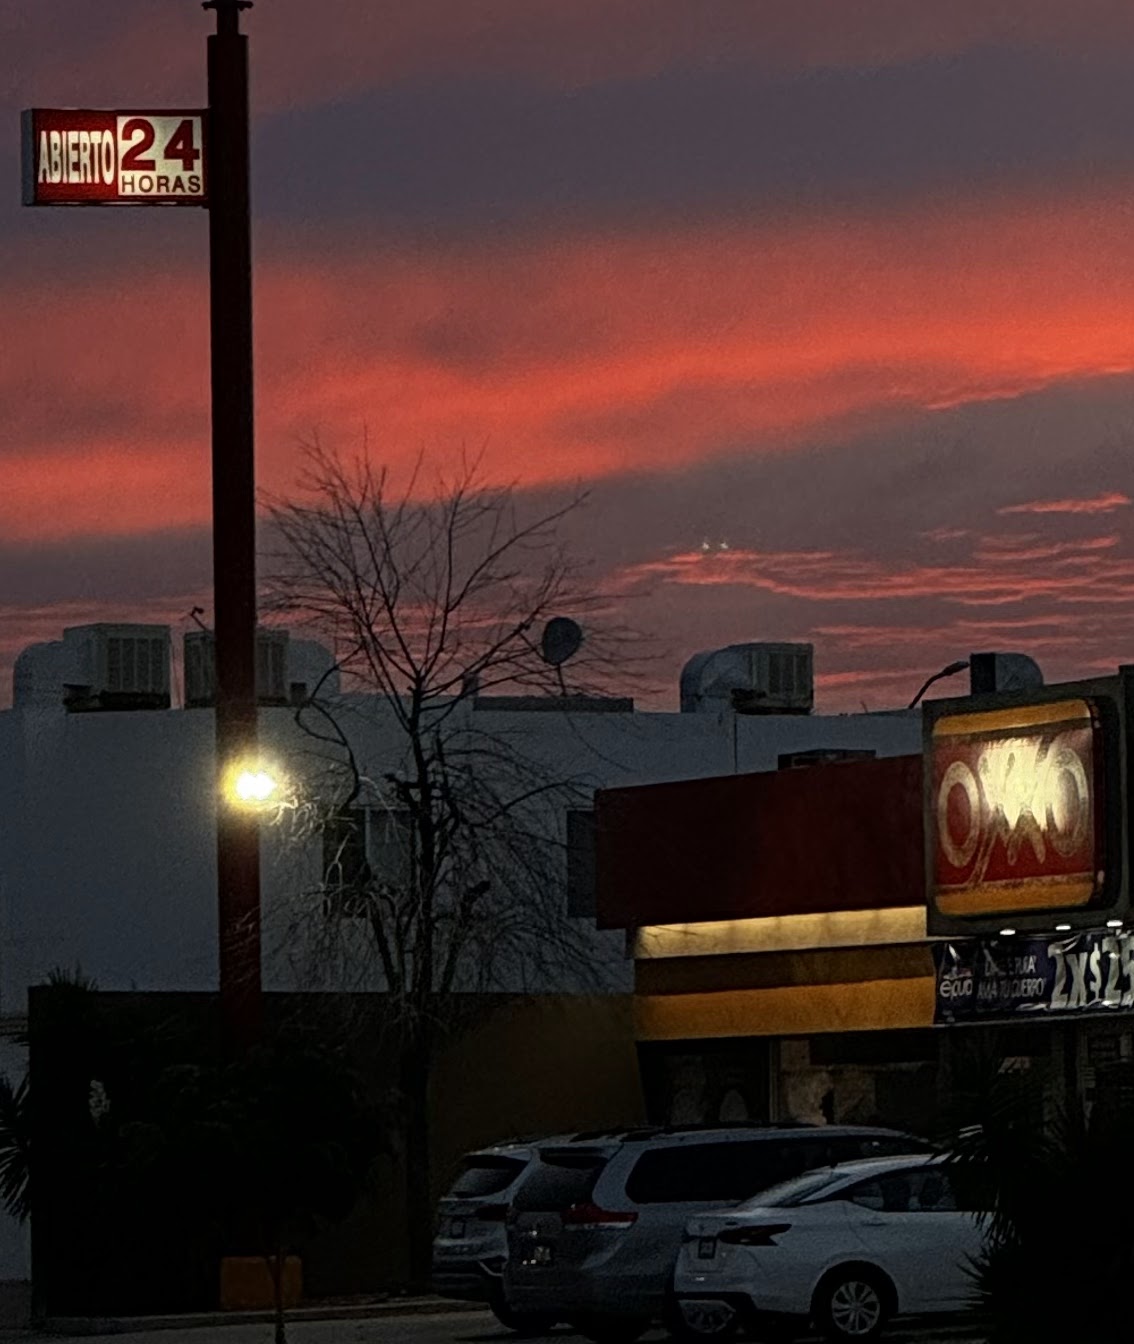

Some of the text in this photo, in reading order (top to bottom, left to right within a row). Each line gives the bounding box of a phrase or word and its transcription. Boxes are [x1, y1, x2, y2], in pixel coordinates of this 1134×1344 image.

[38, 118, 200, 186] ABIERTO 24
[121, 175, 201, 193] HORAS
